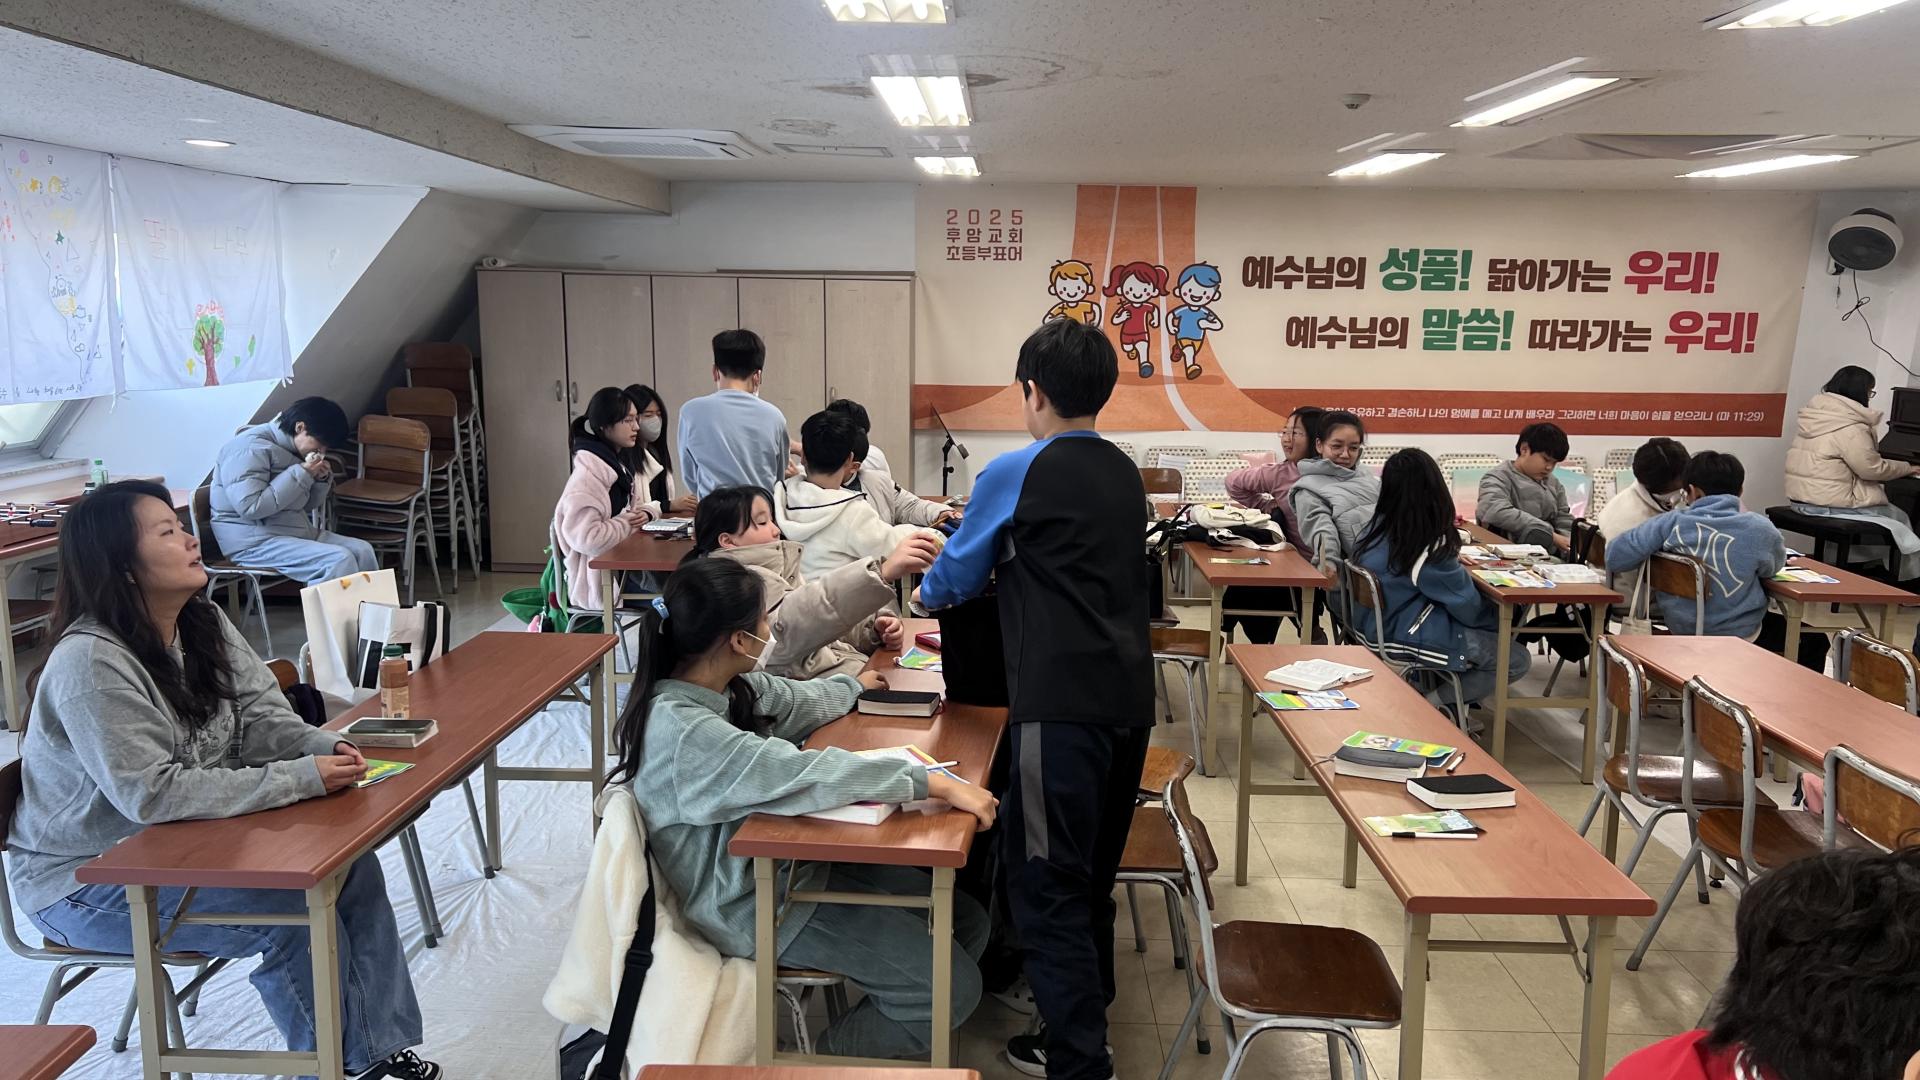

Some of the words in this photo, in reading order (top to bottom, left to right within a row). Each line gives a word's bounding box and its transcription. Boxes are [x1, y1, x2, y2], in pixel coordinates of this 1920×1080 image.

[946, 208, 1023, 225] 2025
[946, 227, 1023, 243] 후암교회
[946, 245, 1023, 261] 초등부표어
[1242, 255, 1367, 290] 예수님의
[1379, 248, 1473, 291] 성품!
[1487, 258, 1611, 293] 닮아가는
[1624, 250, 1719, 294] 우리!
[1285, 315, 1410, 350] 예수님의
[1422, 308, 1515, 351] 말씀!
[1527, 319, 1652, 352] 따라가는
[1664, 310, 1759, 354] 우리!
[1387, 407, 1426, 418] 겸손하니
[1428, 408, 1449, 418] 나의
[1450, 408, 1480, 419] 멍에를
[1481, 408, 1502, 419] 메고
[1503, 409, 1524, 419] 내게
[1525, 409, 1555, 419] 배우라
[1557, 409, 1597, 420] 그리하면
[1598, 410, 1618, 420] 너희
[1619, 410, 1650, 421] 마음이
[1673, 410, 1713, 421] 얻으리니
[1716, 411, 1730, 421] (마
[1733, 411, 1764, 422] 11:29)
